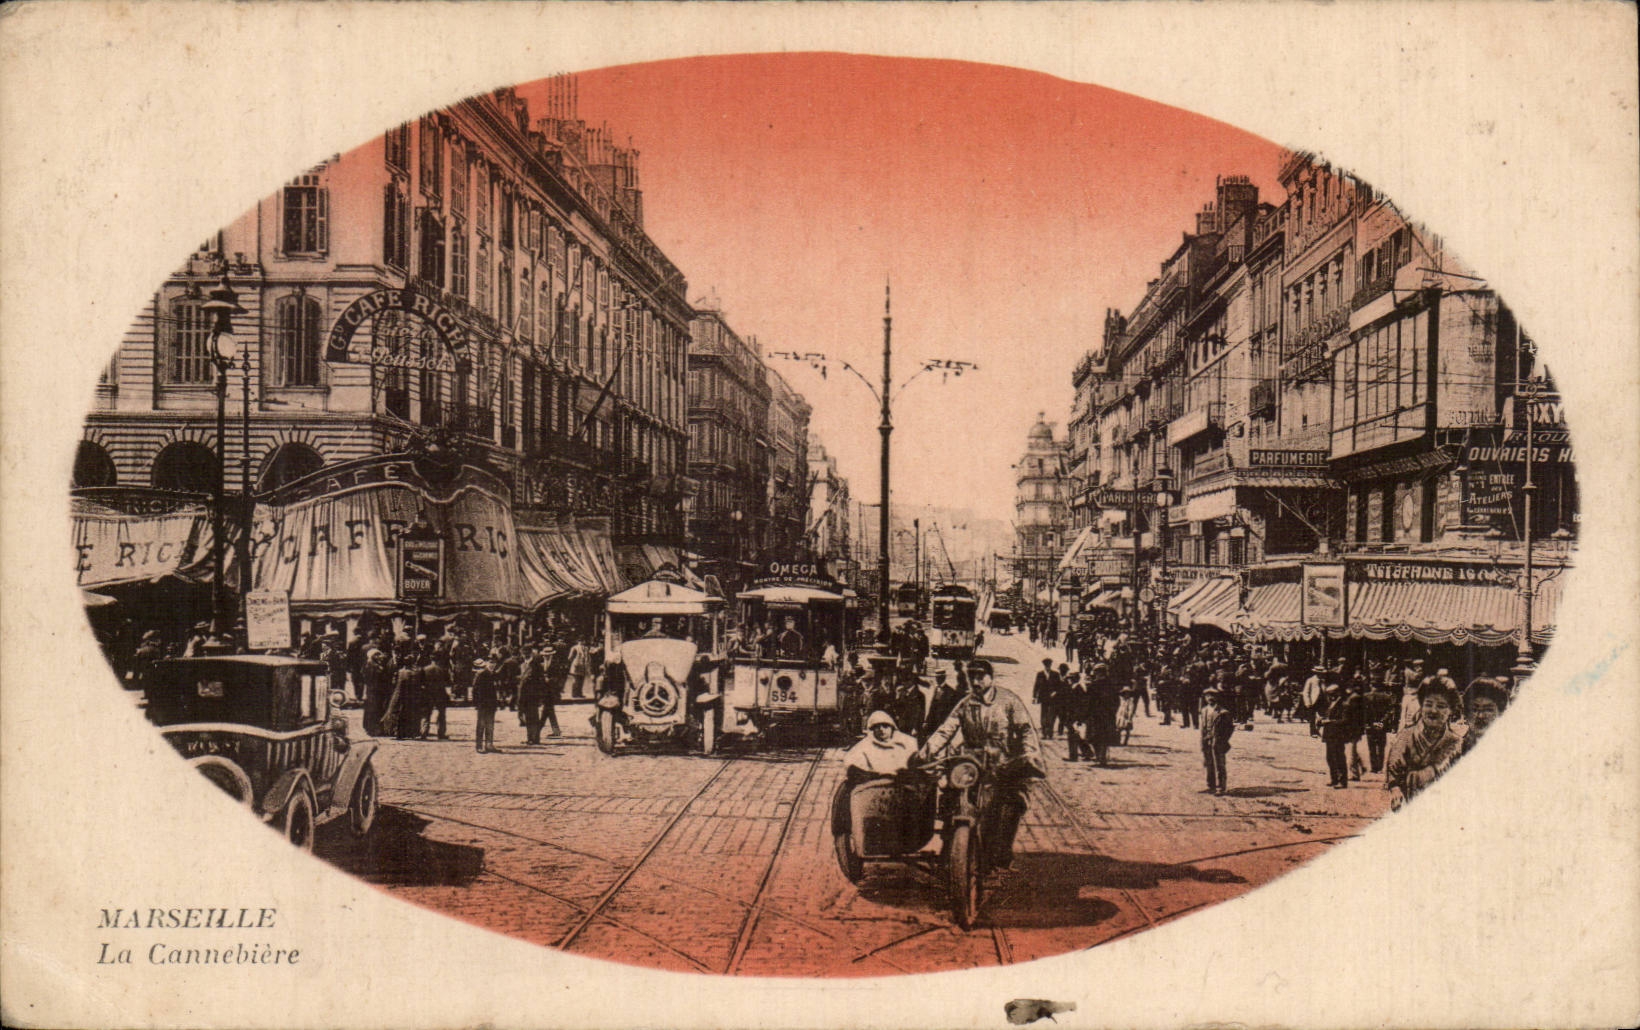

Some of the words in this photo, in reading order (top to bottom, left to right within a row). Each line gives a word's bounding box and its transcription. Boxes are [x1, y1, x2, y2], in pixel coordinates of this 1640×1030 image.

[412, 293, 471, 360] RICHE
[1252, 451, 1325, 465] PARFUMERIE
[769, 561, 818, 576] OMEGA
[404, 579, 431, 590] BOYER
